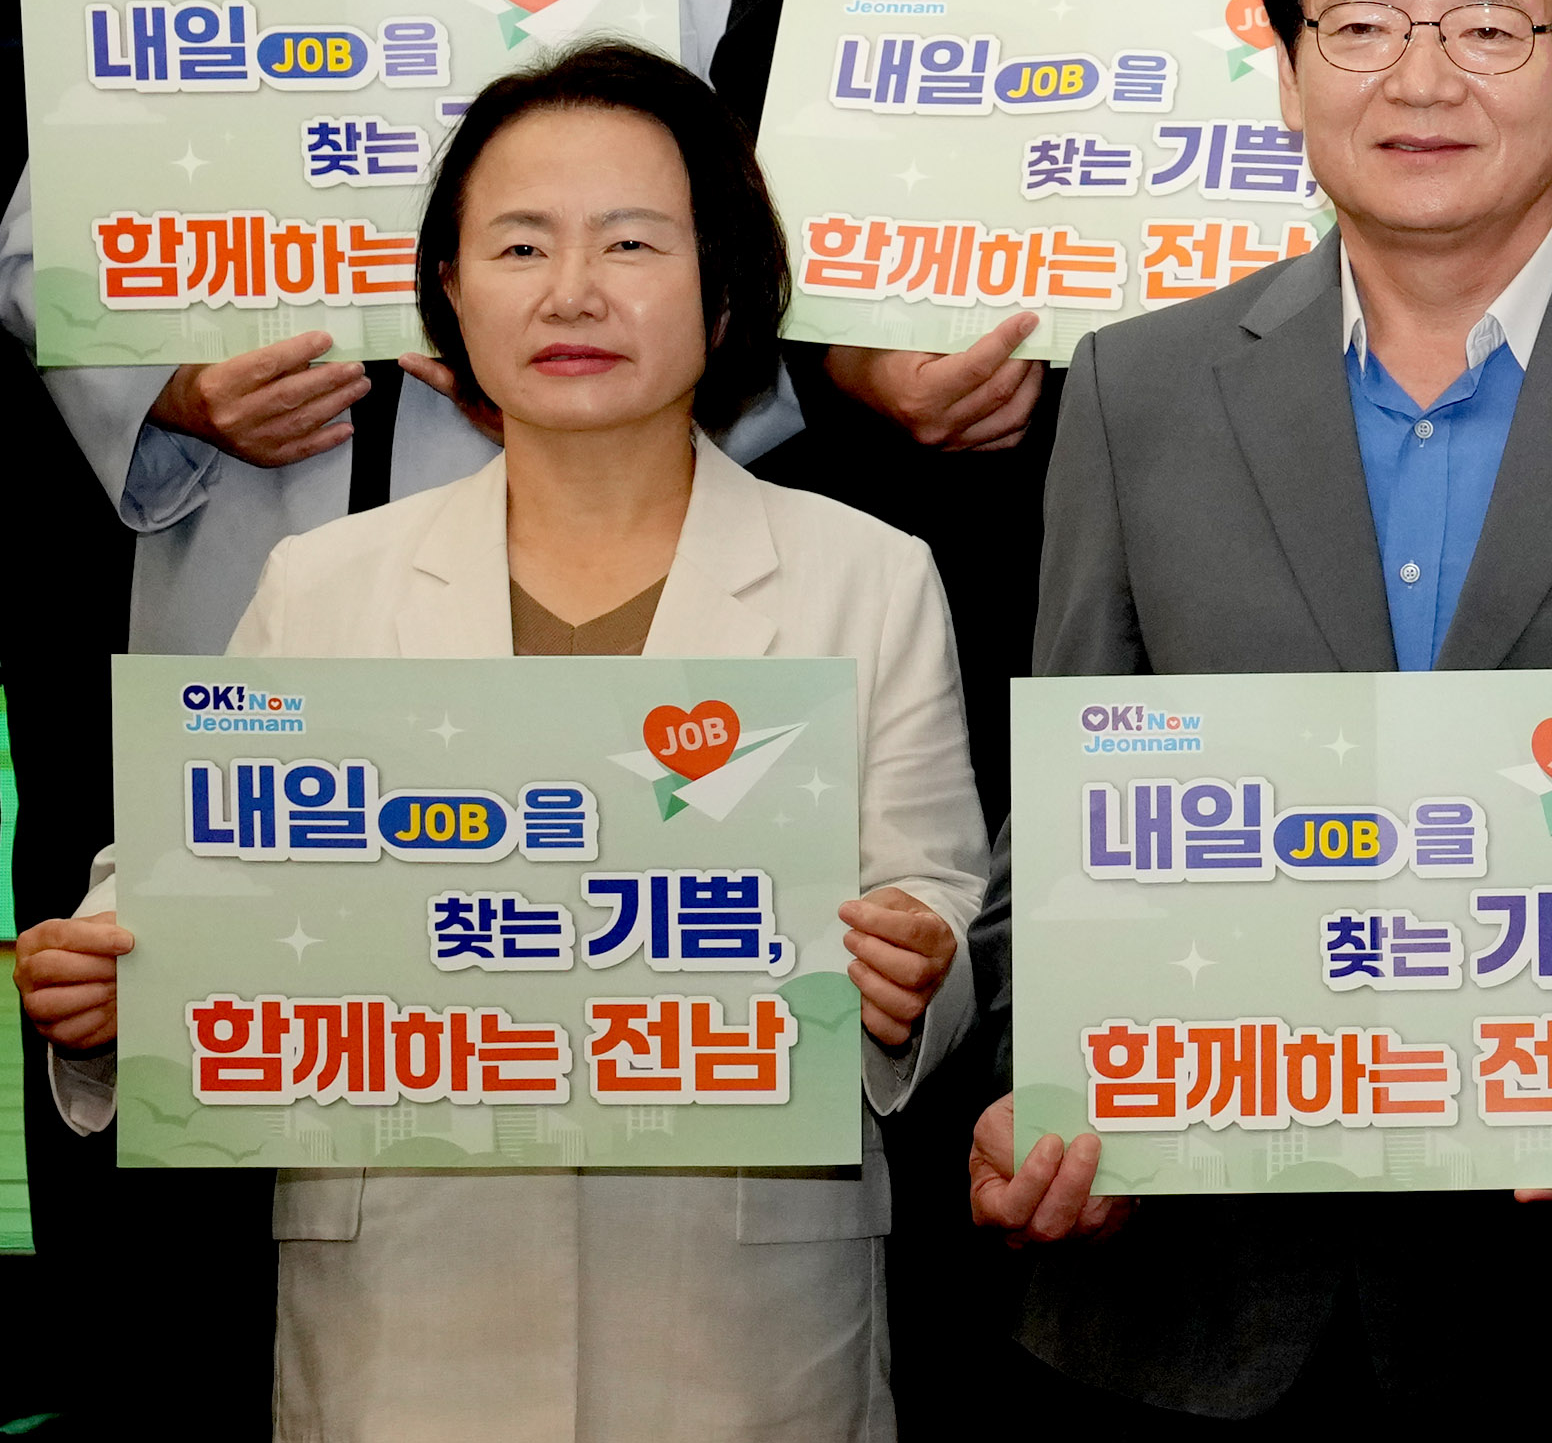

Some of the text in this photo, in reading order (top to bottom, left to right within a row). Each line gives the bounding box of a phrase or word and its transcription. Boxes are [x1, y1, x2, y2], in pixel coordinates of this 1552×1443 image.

[846, 0, 946, 15] Jeonnam
[91, 6, 440, 82] 내일 JOB 을
[835, 39, 1168, 109] 내일 JOB 을
[307, 122, 419, 175] 찾는
[1026, 124, 1318, 198] 찾는 기쁨,
[99, 217, 416, 297] 함께하는
[805, 218, 1118, 300] 함께하는
[183, 685, 303, 712] OK! Now
[185, 714, 304, 733] Jeonnam
[1082, 705, 1201, 732] OK! Now
[659, 717, 728, 757] JOB
[1084, 735, 1201, 754] Jeonnam
[192, 765, 586, 849] 내일 JOB 을
[1089, 784, 1475, 870] 내일 JOB 을
[434, 876, 783, 965] 찾는 기쁨,
[1326, 916, 1449, 978] 찾는
[192, 1000, 786, 1093] 함께하는 전남
[1088, 1024, 1448, 1118] 함께하는
